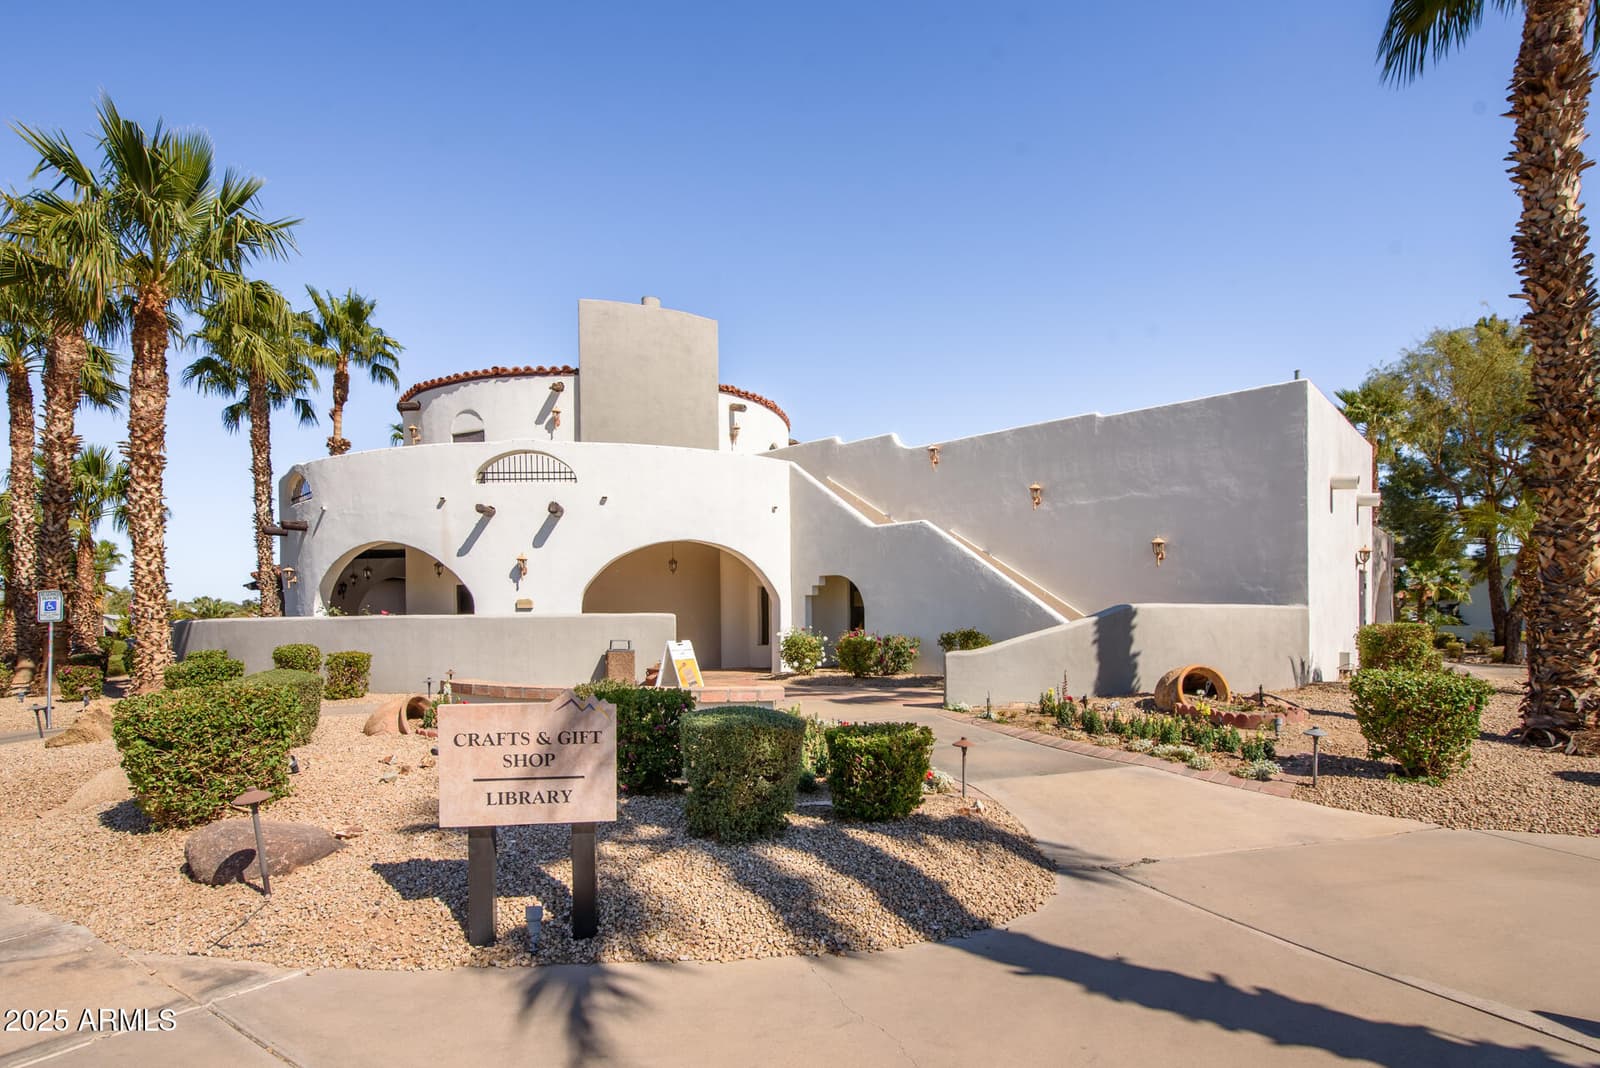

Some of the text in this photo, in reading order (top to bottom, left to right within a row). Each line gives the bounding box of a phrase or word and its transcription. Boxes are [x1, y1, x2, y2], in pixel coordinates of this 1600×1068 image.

[453, 730, 603, 747] CRAFTS & GIFT
[502, 753, 556, 768] SHOP
[486, 789, 573, 806] LIBRARY
